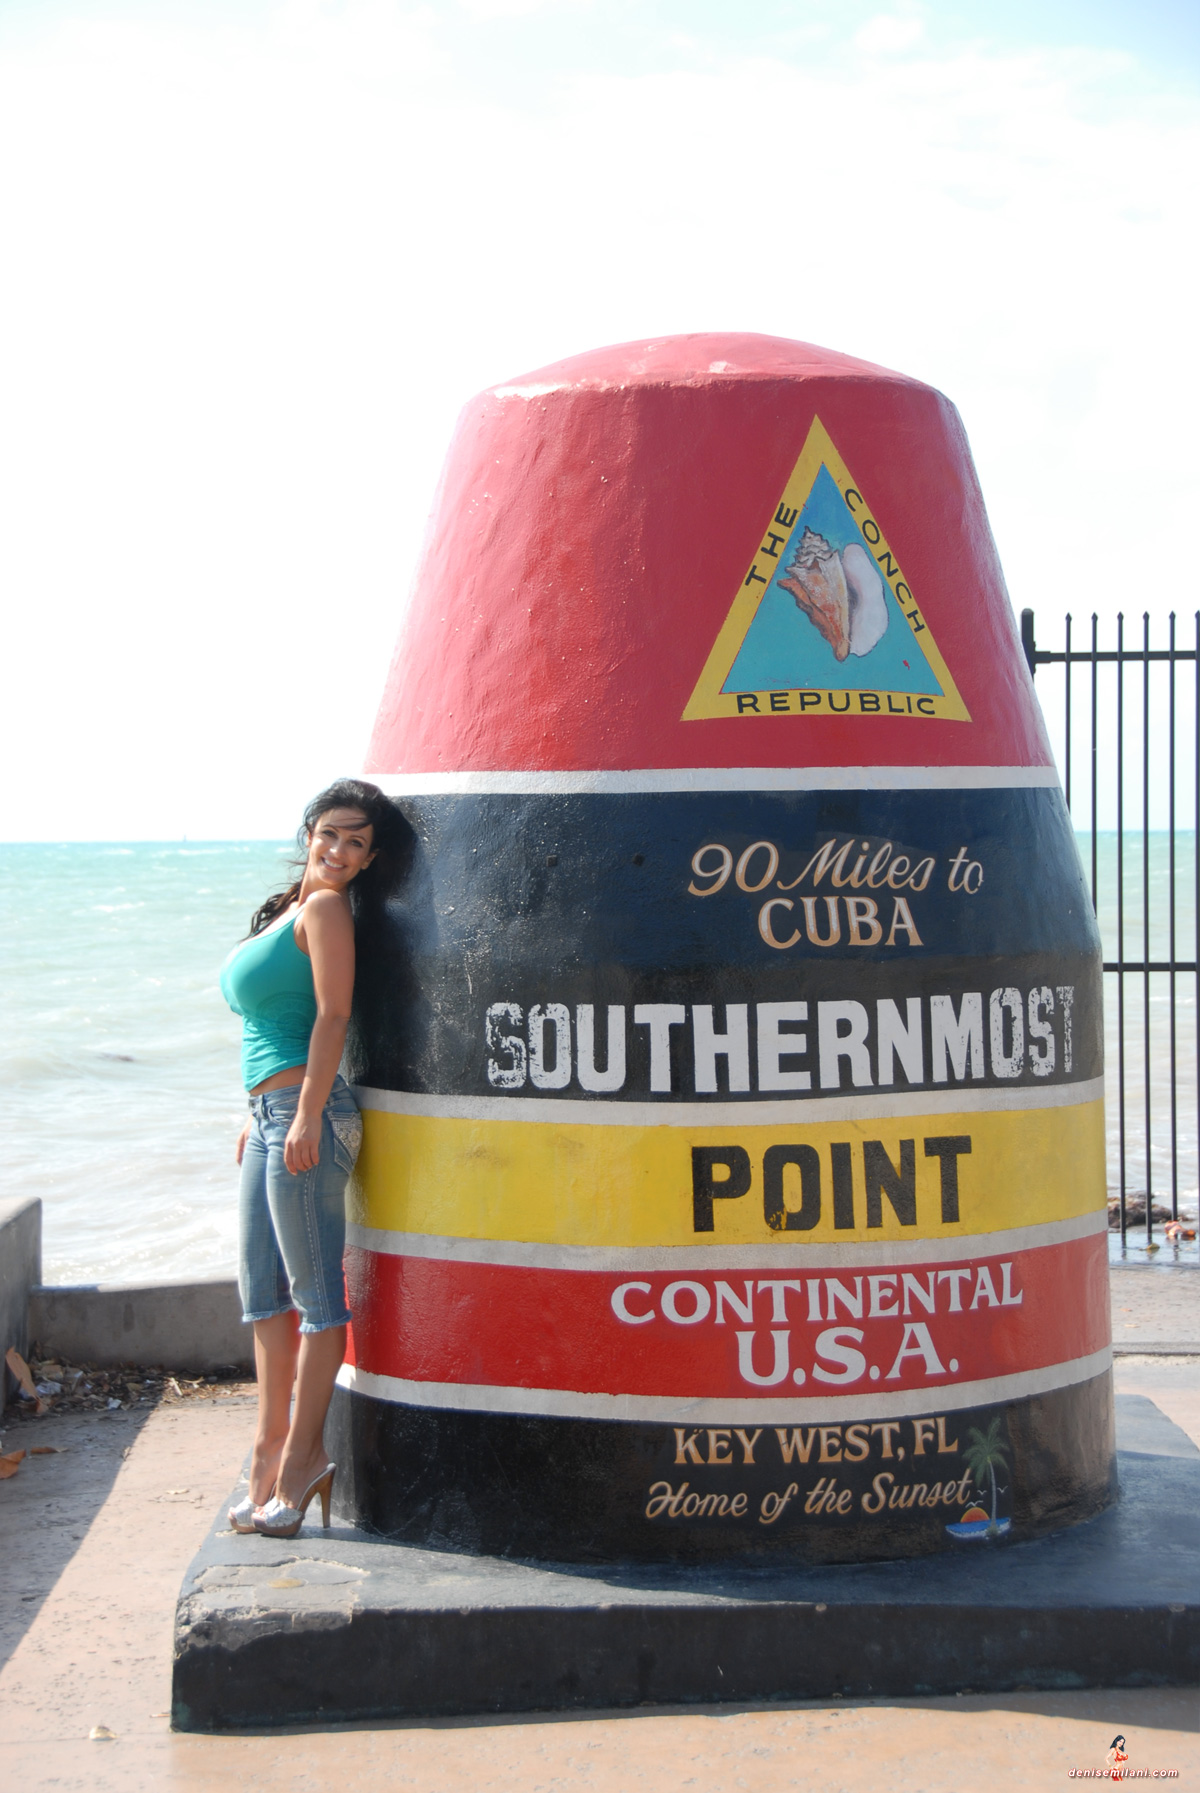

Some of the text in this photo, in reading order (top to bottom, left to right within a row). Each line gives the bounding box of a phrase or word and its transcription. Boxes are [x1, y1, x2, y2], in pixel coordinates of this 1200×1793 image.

[744, 501, 800, 588] THE
[844, 488, 925, 634] CONCH
[736, 691, 936, 715] REPUBLIC
[688, 838, 984, 897] 90 Miles to
[757, 896, 925, 950] CUBA
[484, 986, 1075, 1094] SOUTHERNMOST
[691, 1135, 972, 1233] POINT
[610, 1261, 1024, 1325] CONTINENTAL
[735, 1321, 960, 1386] U.S.A.
[673, 1416, 959, 1464] KEY WEST, FL
[645, 1466, 973, 1525] Home of the Sunset
